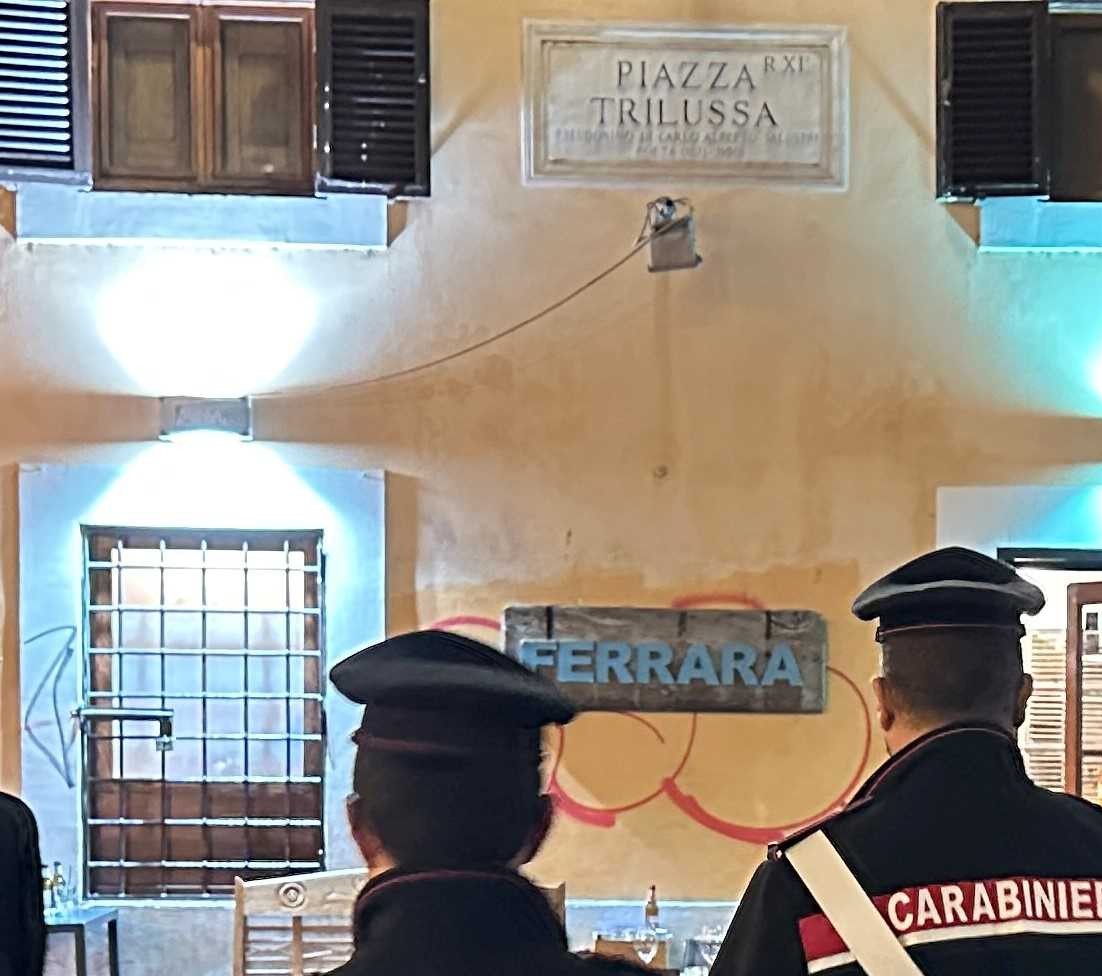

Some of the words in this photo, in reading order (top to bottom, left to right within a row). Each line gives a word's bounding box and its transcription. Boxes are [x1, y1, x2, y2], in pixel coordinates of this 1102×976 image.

[616, 60, 756, 90] PIAZZA
[590, 97, 778, 128] TRILUSSA
[519, 639, 803, 687] FERRARA
